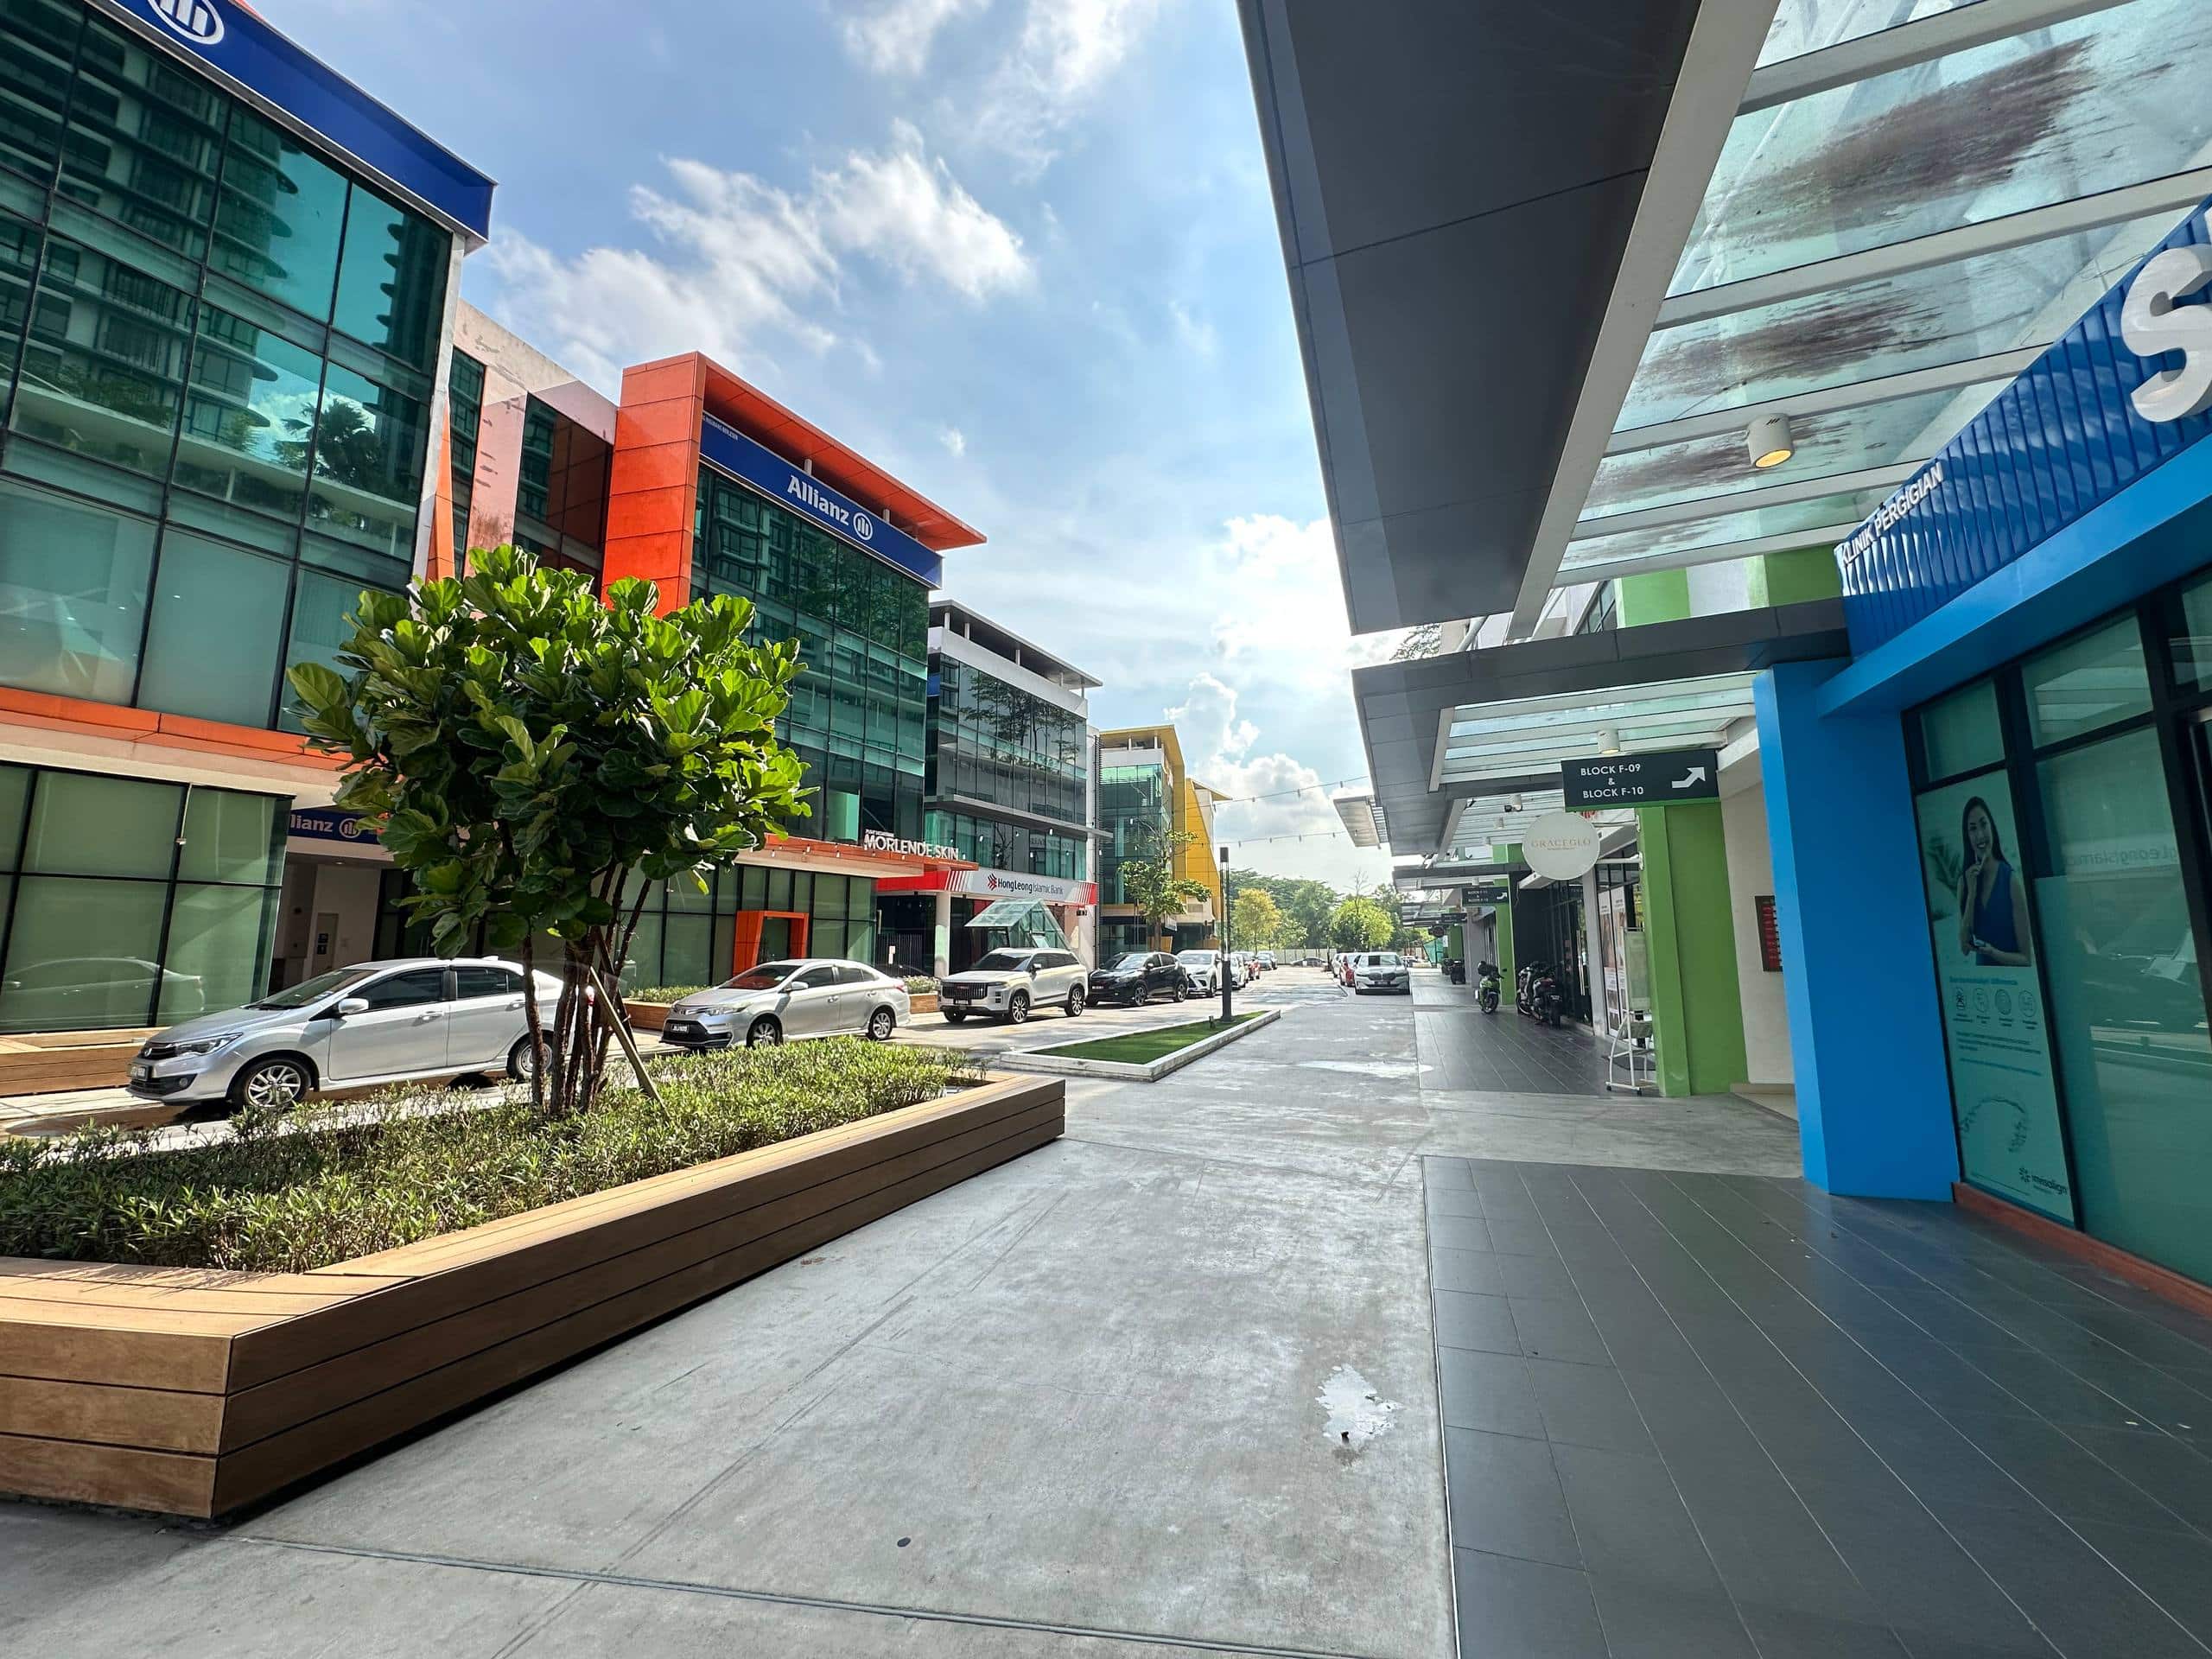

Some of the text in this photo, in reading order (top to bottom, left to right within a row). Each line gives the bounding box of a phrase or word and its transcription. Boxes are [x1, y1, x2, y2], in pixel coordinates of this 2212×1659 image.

[2121, 212, 2212, 423] S
[787, 474, 849, 526] Allianz
[1841, 461, 1944, 564] KLINIK PERGIGIAN
[1580, 763, 1641, 776] BLOCK F-09
[1583, 786, 1643, 798] BLOCK F-10
[289, 814, 334, 832] lianz
[864, 834, 958, 861] MORLENDE SKIN
[1051, 885, 1065, 895] Bank
